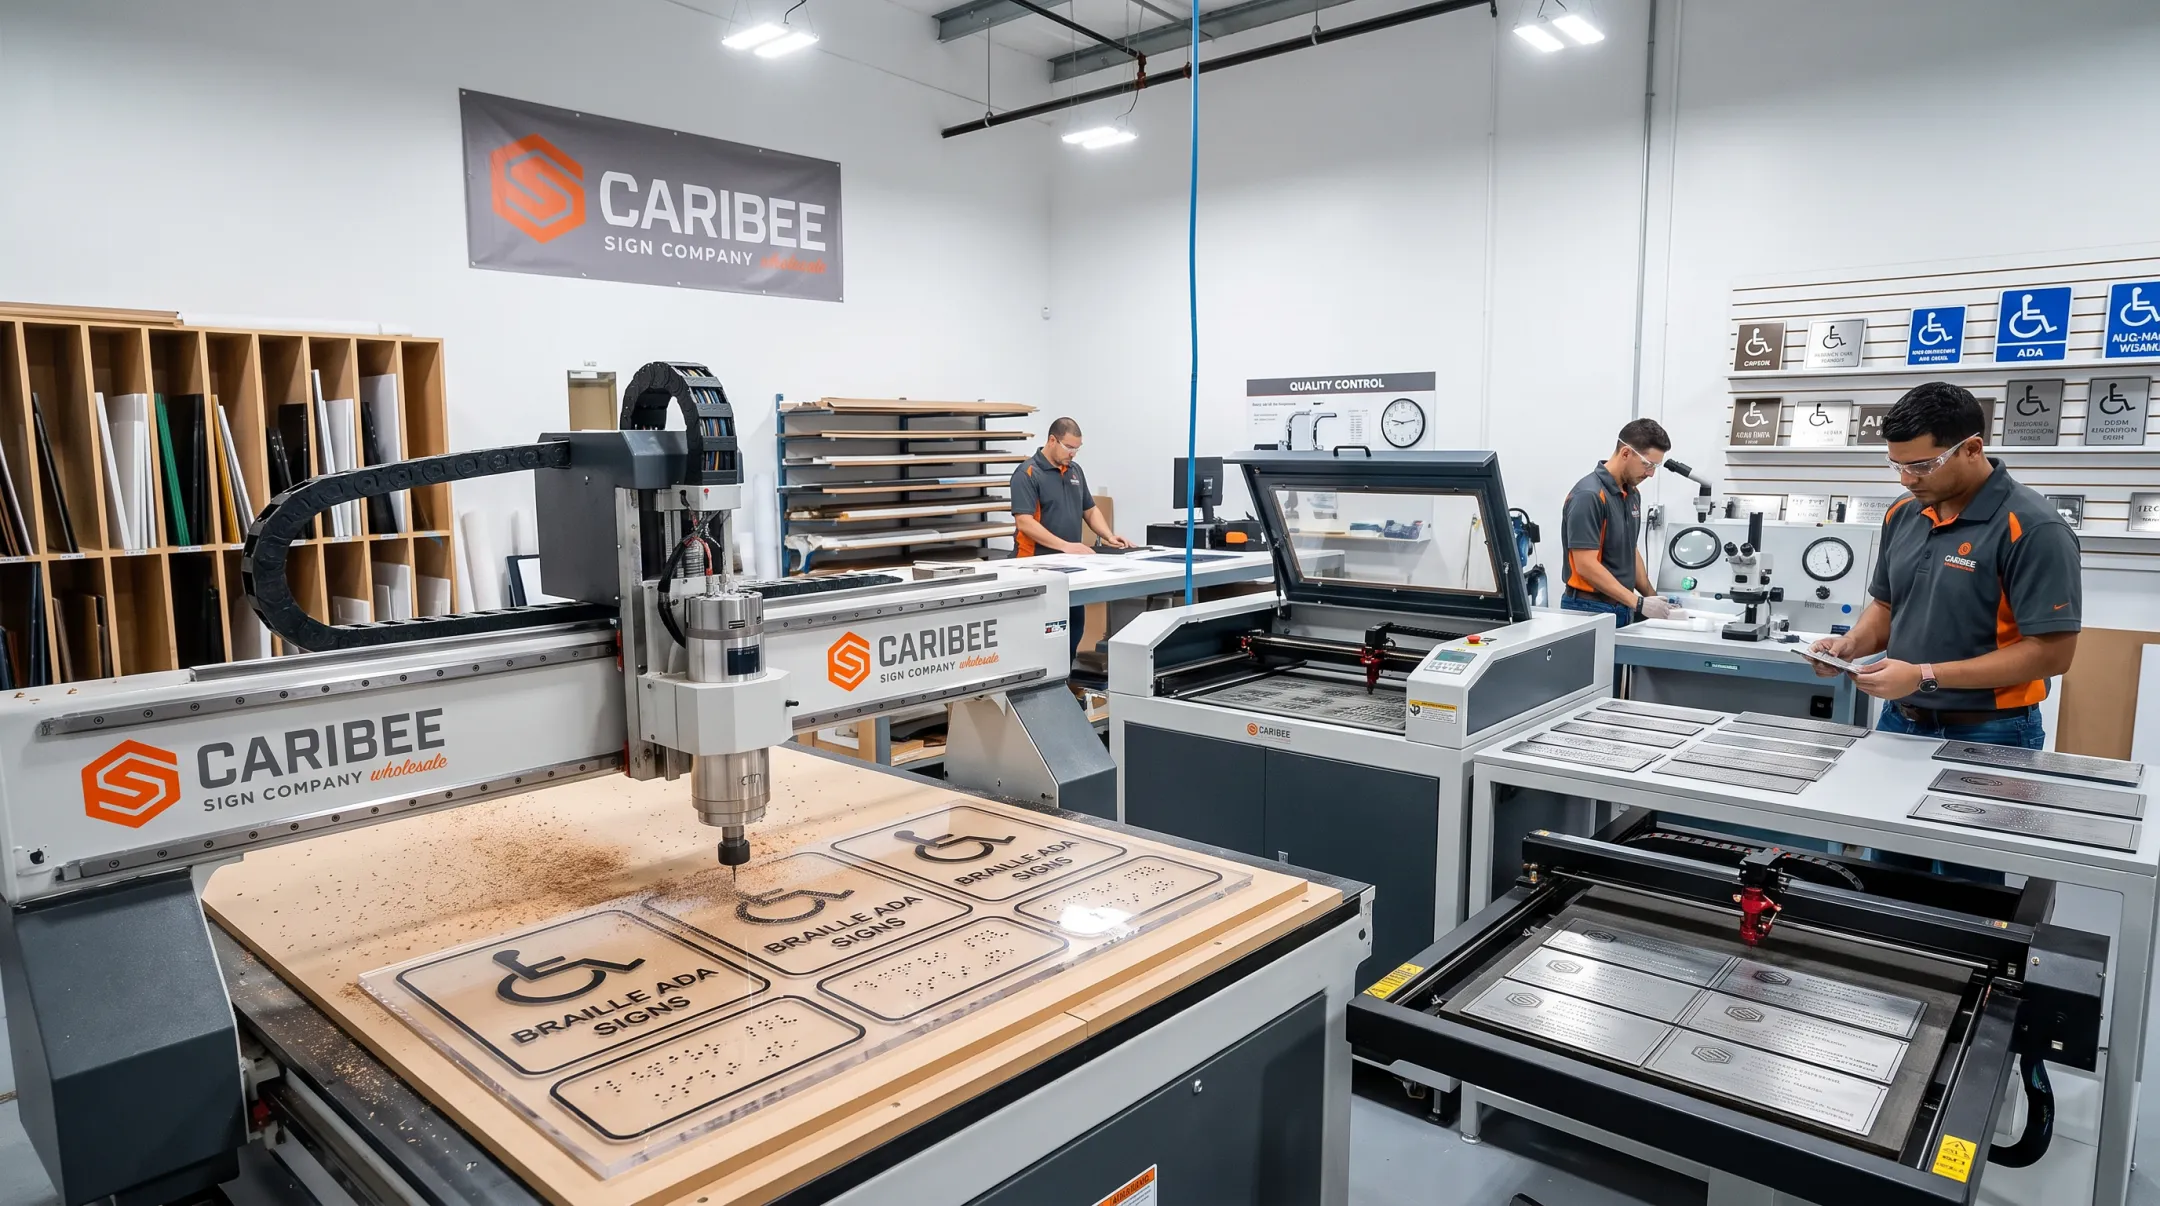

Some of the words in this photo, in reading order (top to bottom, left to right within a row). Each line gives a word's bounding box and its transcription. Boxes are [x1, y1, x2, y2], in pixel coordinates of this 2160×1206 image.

[599, 169, 827, 252] CARIBEE
[604, 235, 653, 256] SIGN
[661, 242, 753, 267] COMPANY
[2016, 348, 2044, 358] ADA
[1289, 380, 1332, 392] QUALITY
[1334, 378, 1385, 390] CONTROL
[878, 619, 998, 668] CARIBEE
[880, 669, 904, 684] SIGN
[908, 661, 956, 679] COMPANY
[197, 707, 446, 790] CARIBEE
[1259, 725, 1291, 739] CARIBEE
[203, 791, 254, 813] SIGN
[263, 771, 363, 802] COMPANY
[370, 752, 448, 782] wholesale
[1038, 840, 1081, 858] ADA
[1012, 855, 1074, 883] SIGNS
[763, 911, 873, 955] BRAILLE
[873, 895, 924, 918] ADA
[831, 916, 907, 949] SIGNS
[510, 989, 652, 1045] BRAILLE
[656, 967, 719, 995] ADA
[593, 995, 692, 1037] SIGNS
